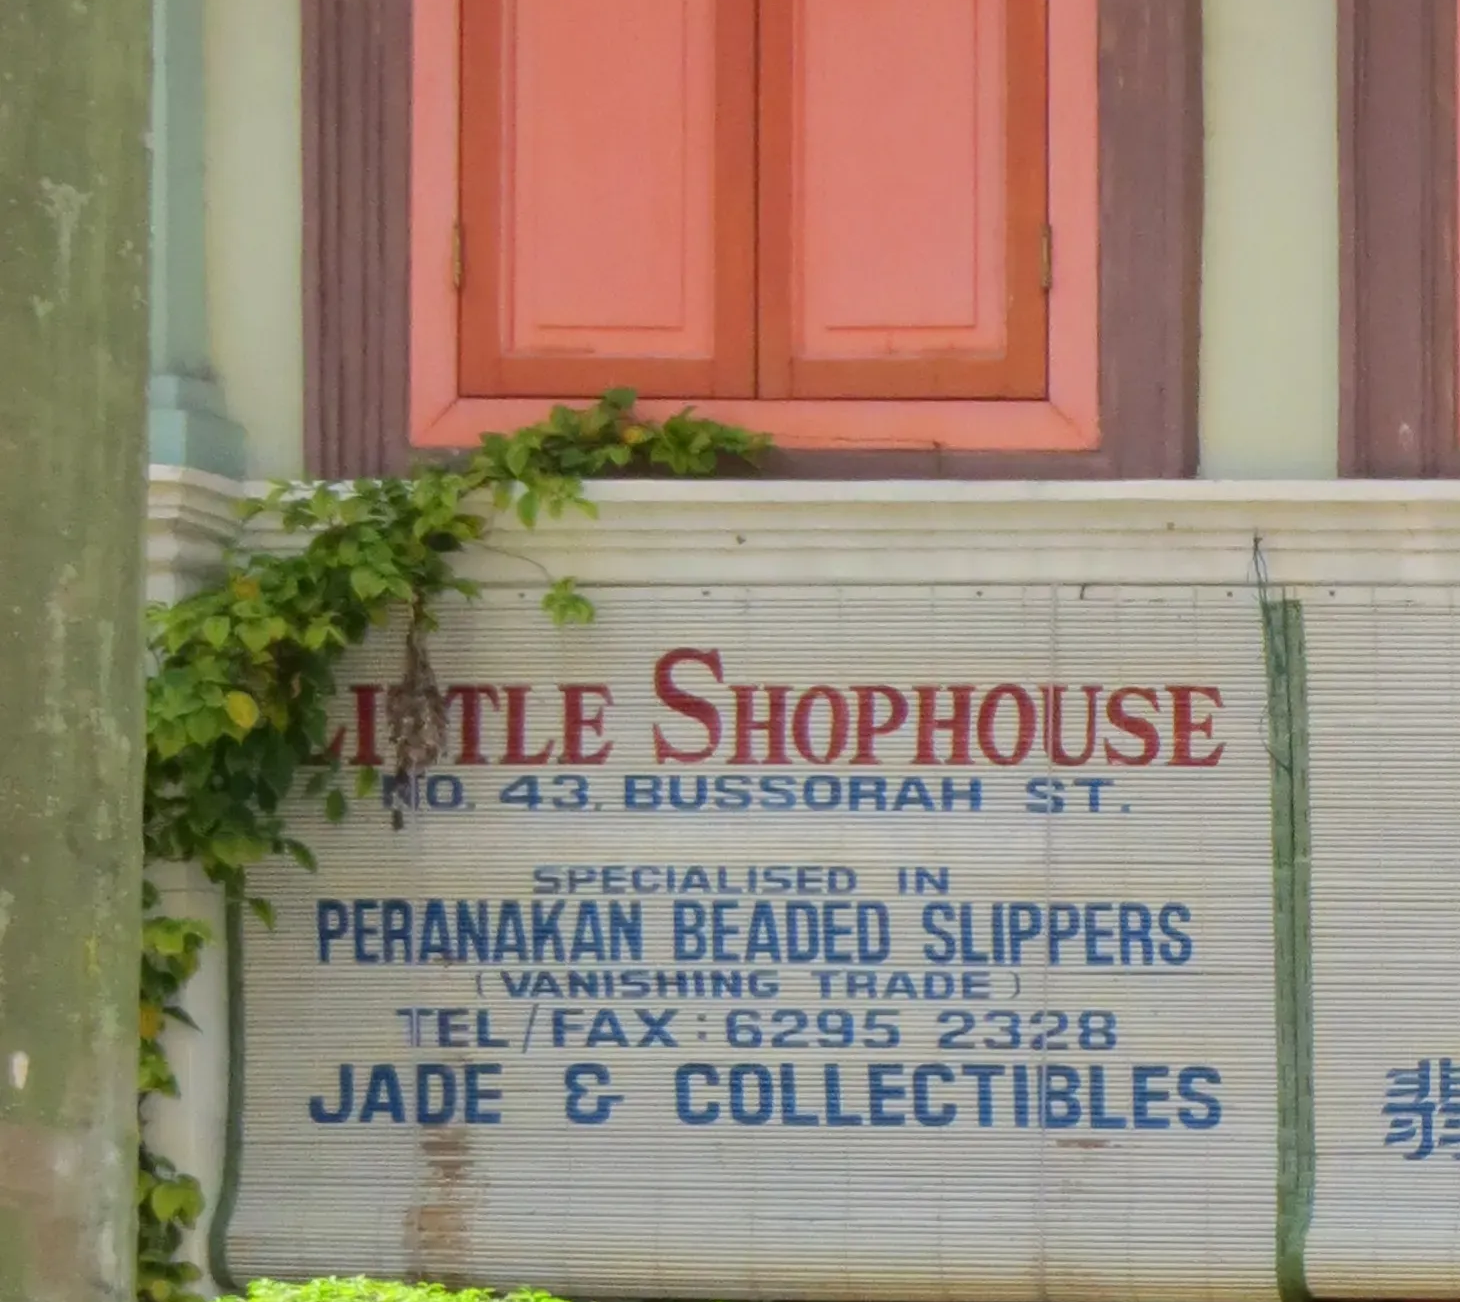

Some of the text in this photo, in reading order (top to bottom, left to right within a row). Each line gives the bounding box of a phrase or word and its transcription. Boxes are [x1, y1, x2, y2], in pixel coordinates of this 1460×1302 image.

[301, 647, 1225, 767] ITLE SHOPHOUSE
[624, 774, 984, 814] BUSSORAH
[1024, 775, 1132, 815] ST.
[533, 865, 950, 897] SPECIALISED IN
[317, 899, 1195, 968] PERANAKAN BEADED SLIPPERS
[475, 967, 1021, 1002] (VANISHING TRADE)
[937, 1007, 1119, 1052] 2328
[309, 1061, 1224, 1132] JADE & COLLECTIBLES
